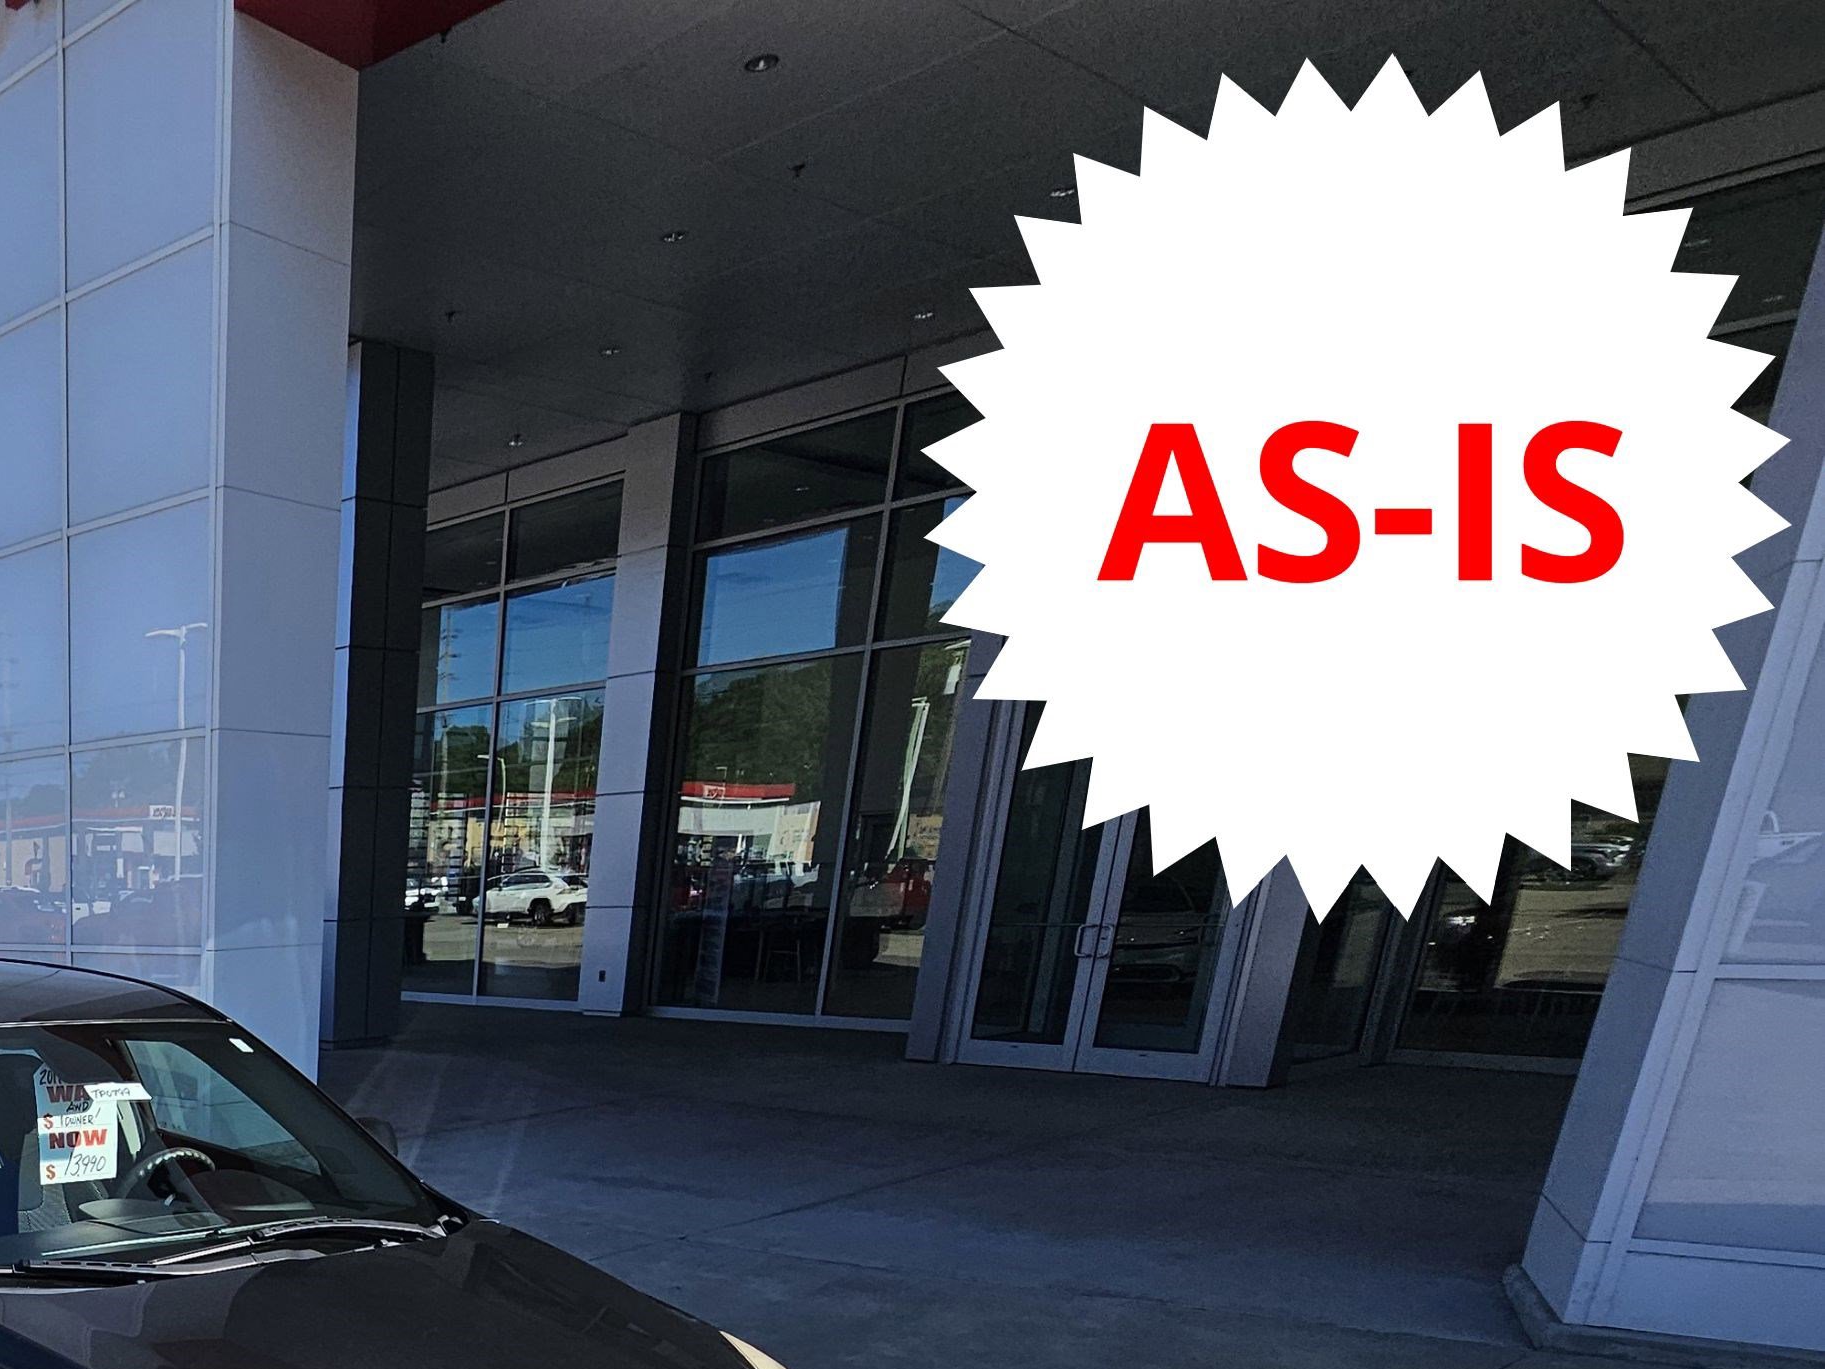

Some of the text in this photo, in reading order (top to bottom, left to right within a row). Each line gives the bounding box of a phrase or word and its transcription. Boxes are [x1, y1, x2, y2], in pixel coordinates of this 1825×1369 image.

[46, 1084, 89, 1104] WA
[66, 1101, 90, 1113] AWD
[49, 1129, 107, 1150] NOW
[46, 1164, 56, 1180] $
